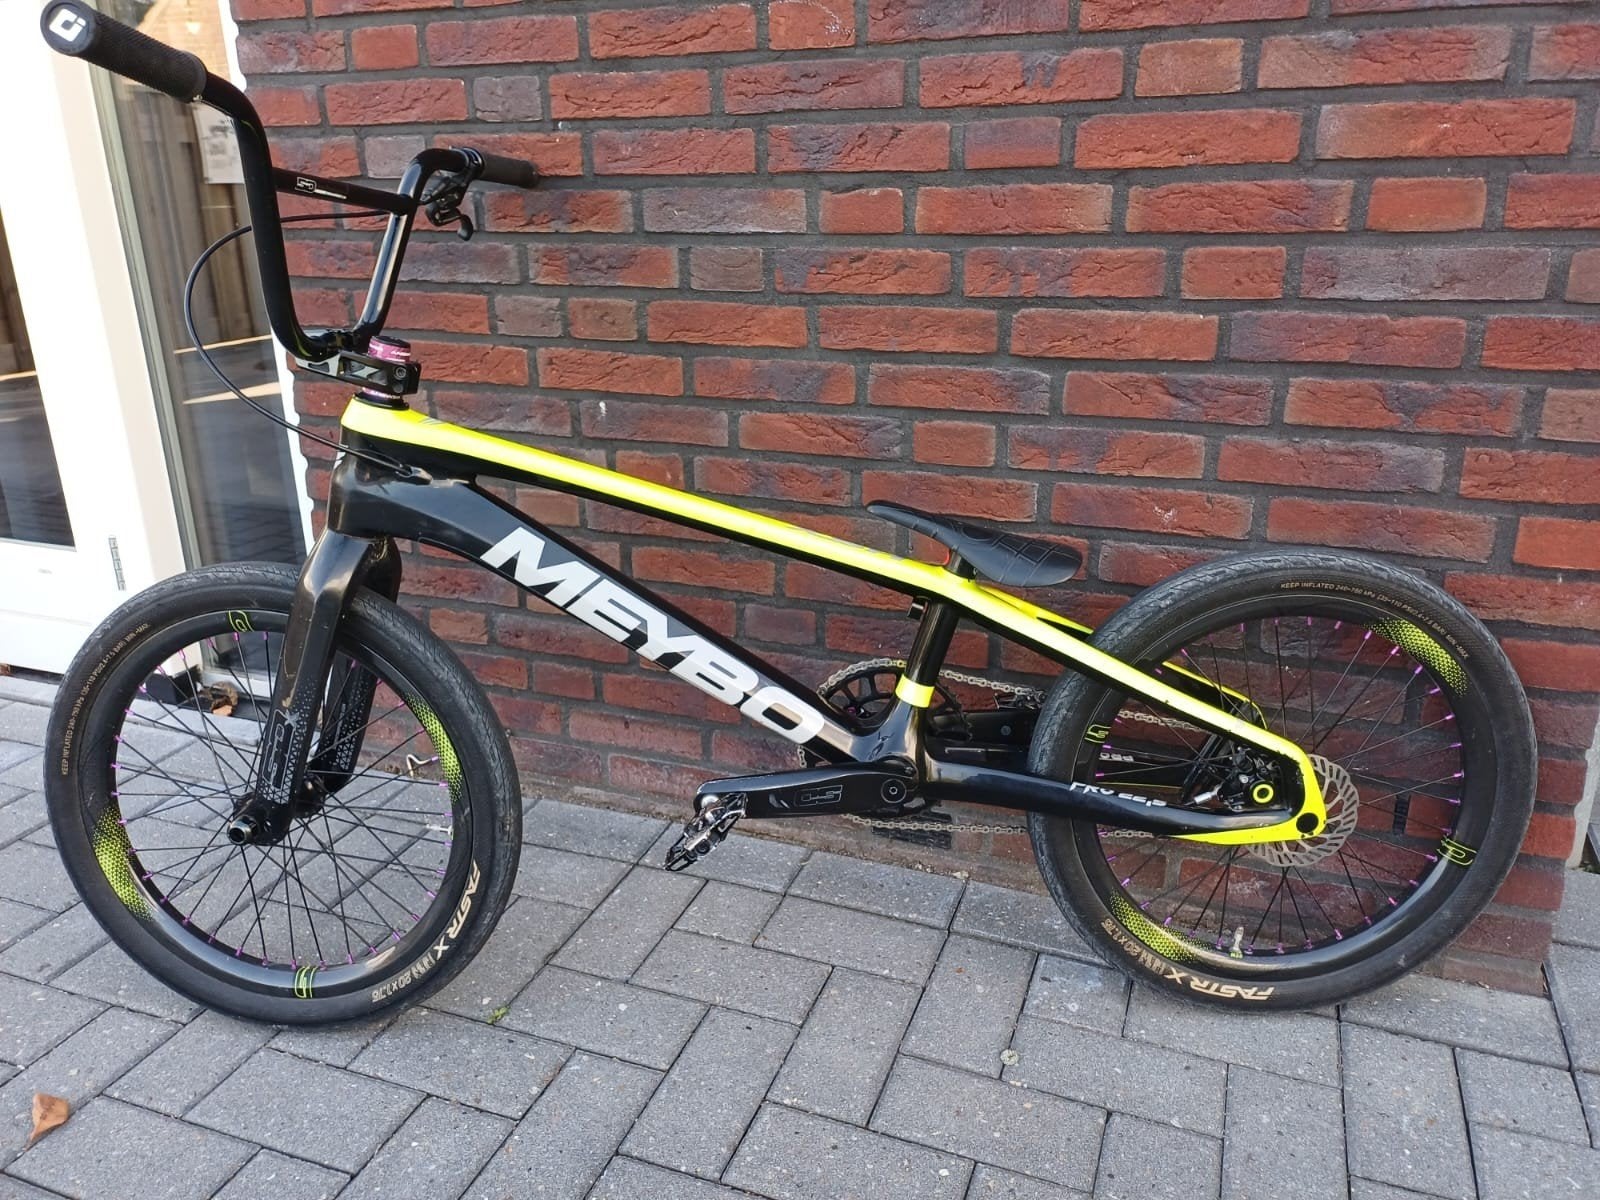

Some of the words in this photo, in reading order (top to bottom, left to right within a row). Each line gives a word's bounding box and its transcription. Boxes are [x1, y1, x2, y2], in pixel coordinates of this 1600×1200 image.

[1301, 582, 1335, 590] INFLATED
[480, 527, 826, 744] MEYBO
[62, 728, 73, 756] INFLATED
[61, 757, 69, 775] KEEP
[445, 859, 481, 939] FASTR
[1190, 975, 1275, 1001] FASTR
